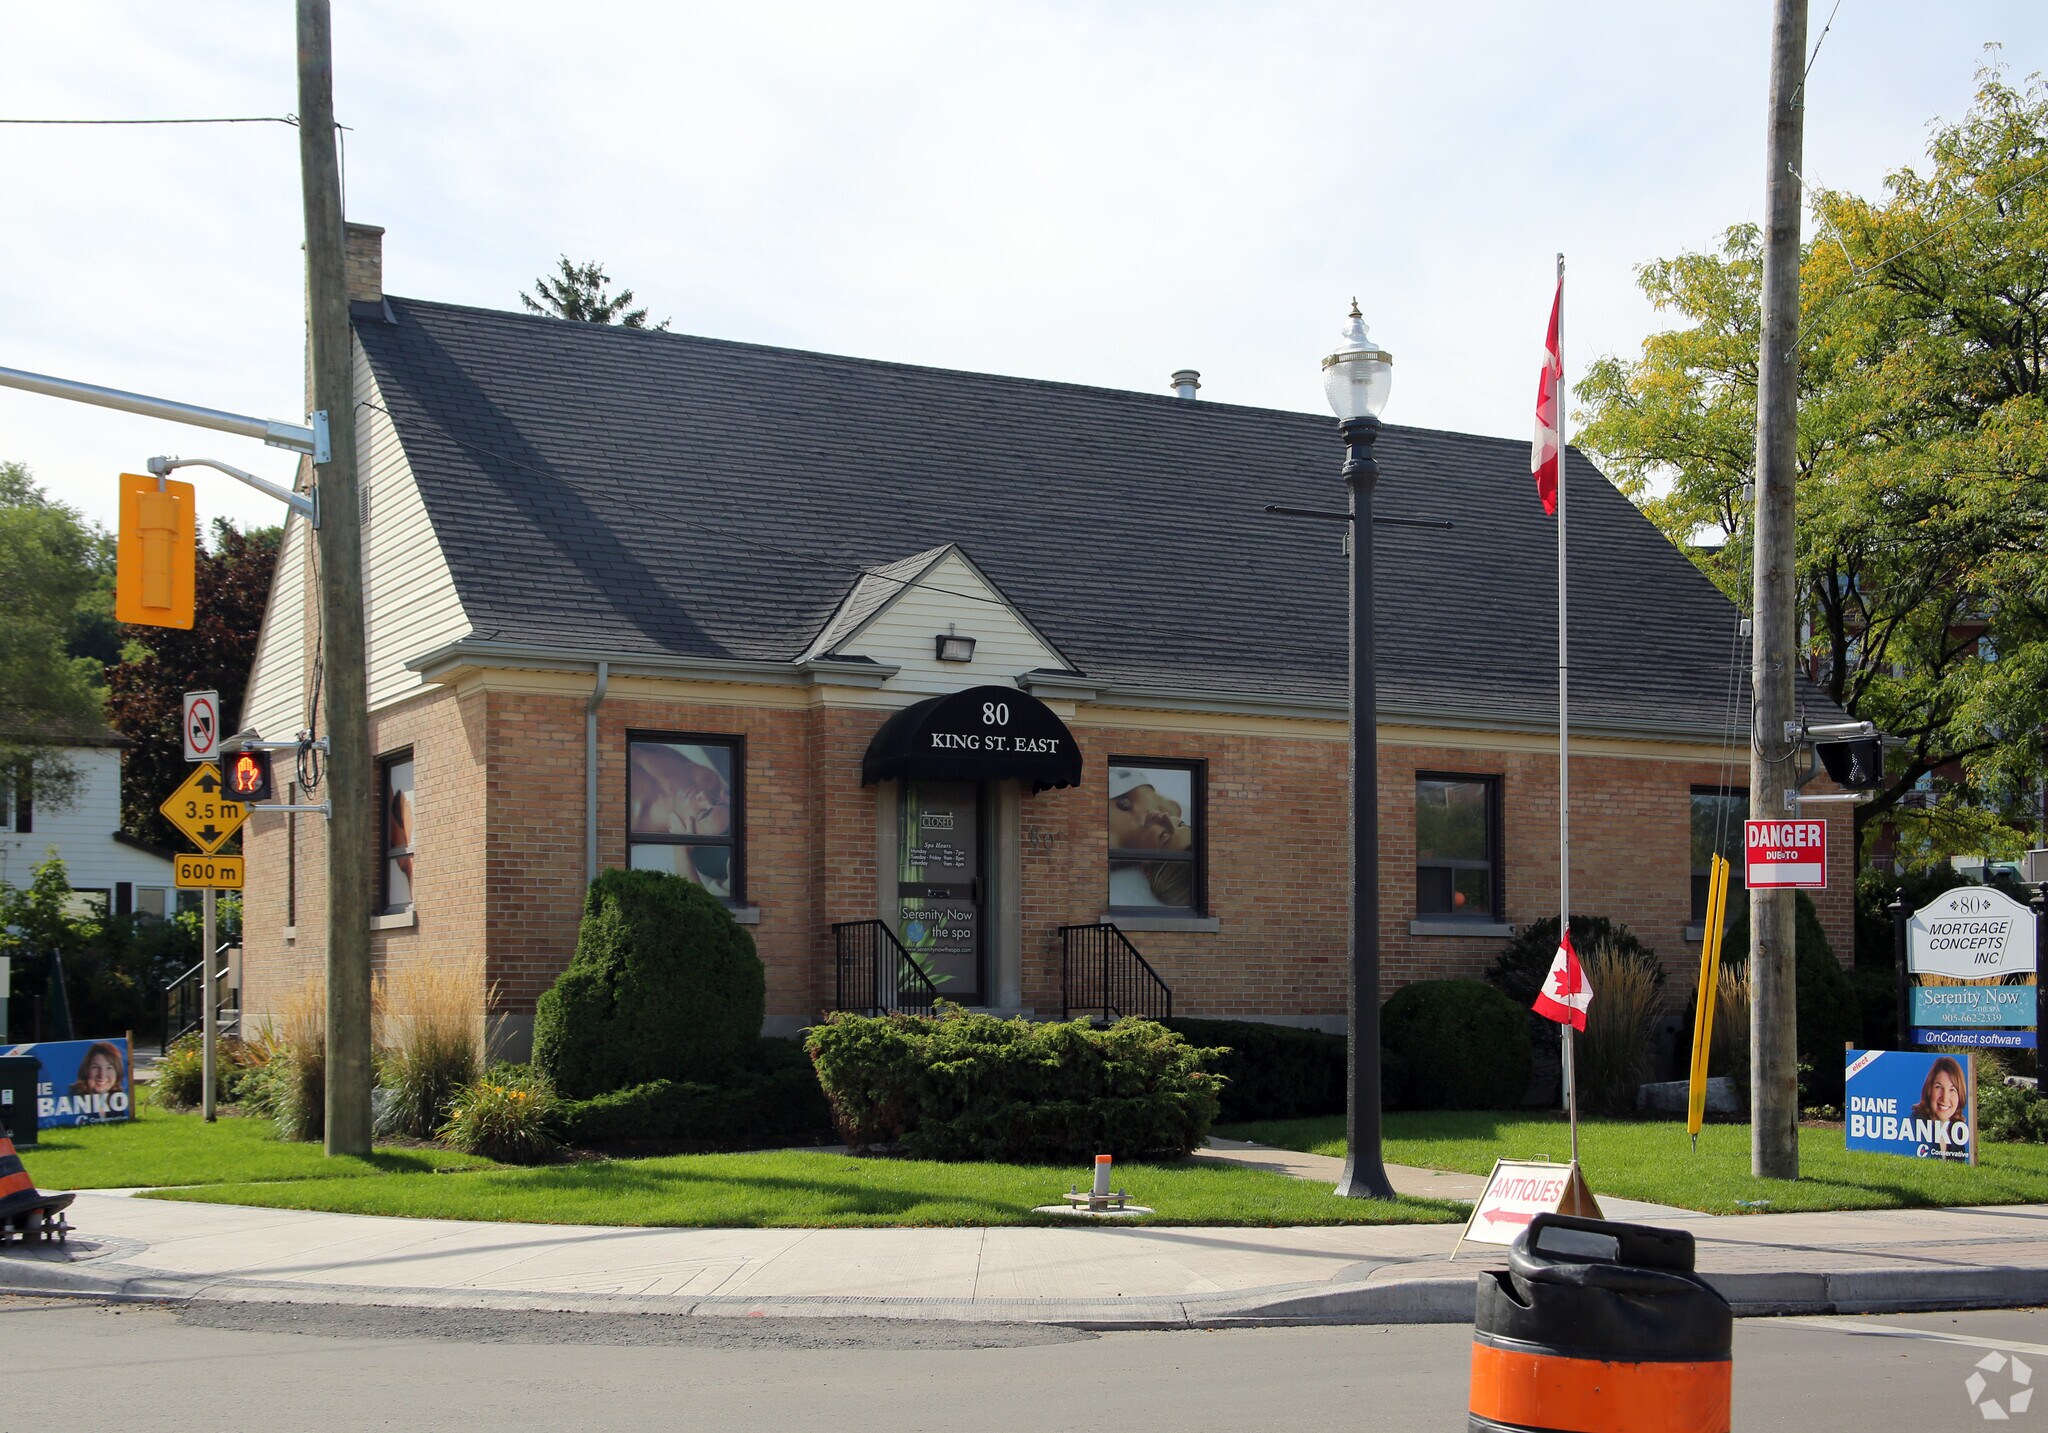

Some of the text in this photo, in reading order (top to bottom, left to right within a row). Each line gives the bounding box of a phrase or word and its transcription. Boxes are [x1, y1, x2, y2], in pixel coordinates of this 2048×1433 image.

[982, 702, 1009, 725] 80
[931, 733, 1059, 753] KING ST. EAST
[185, 801, 238, 819] 3.5 m
[922, 816, 954, 828] CLOSED
[1748, 824, 1821, 848] DANGER
[1766, 850, 1798, 860] DUE TO
[181, 864, 236, 880] 600 m
[1960, 896, 1980, 915] 80
[902, 907, 973, 923] Serenity Now
[932, 925, 971, 941] the spa
[1929, 922, 2009, 936] MORTGAGE
[1930, 937, 2004, 950] CONCEPTS
[1974, 952, 2000, 965] INC
[1924, 988, 2020, 1008] Serenity Now
[1942, 1013, 2002, 1023] 905-662-2339
[1980, 1033, 2021, 1046] software
[1852, 1056, 1869, 1072] elect
[37, 1092, 129, 1118] BANKO
[1851, 1096, 1897, 1114] DIANE
[1850, 1114, 1970, 1146] BUBANKO
[1930, 1148, 1969, 1158] Conservative
[1488, 1177, 1564, 1203] ANTIQUES
